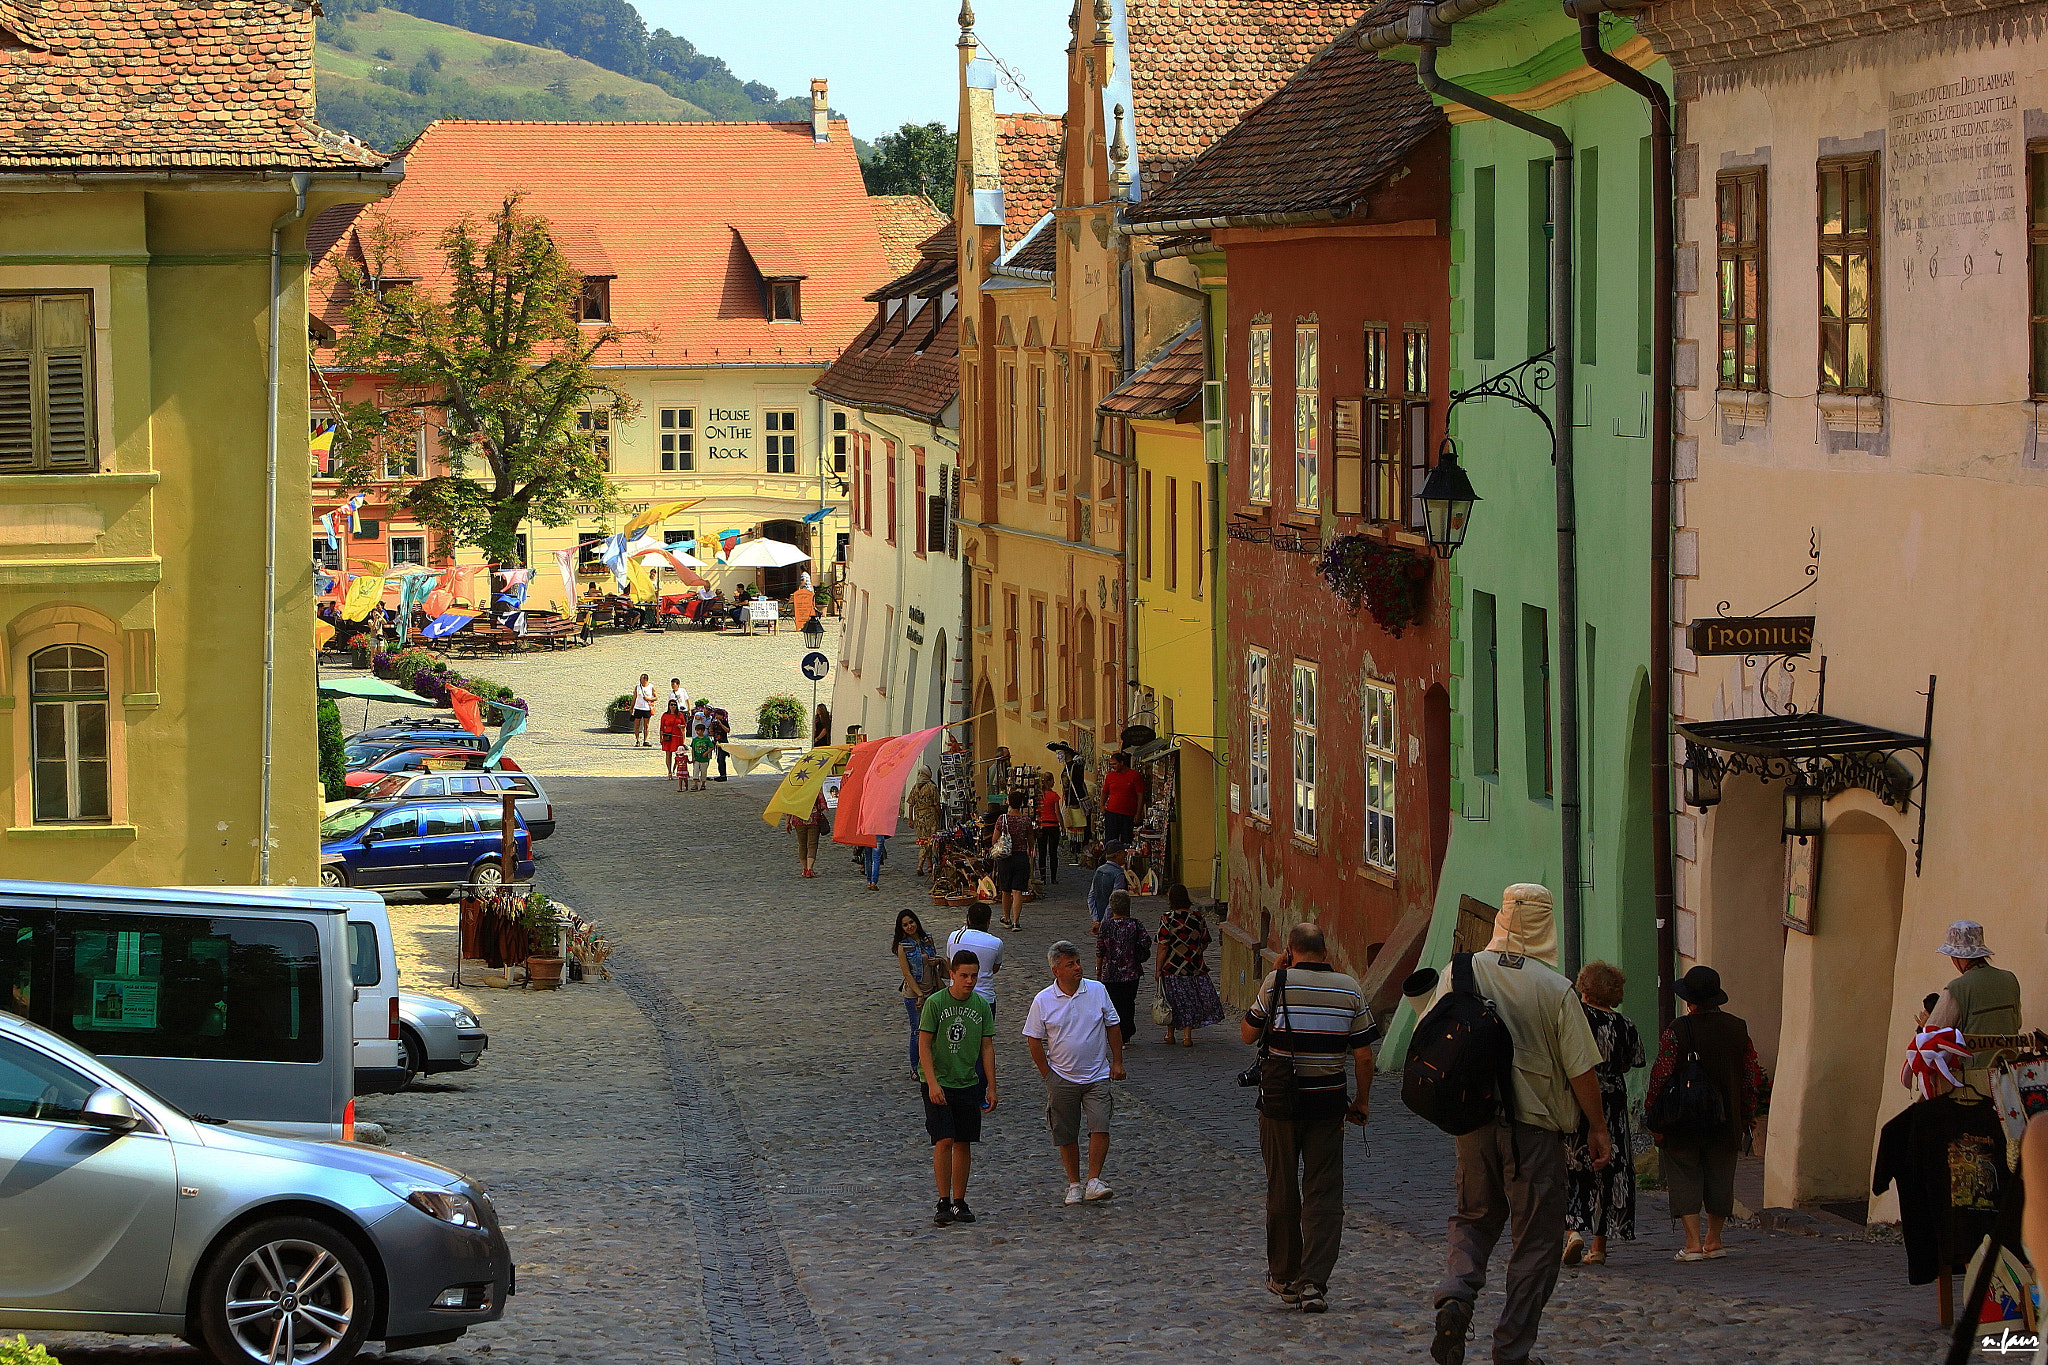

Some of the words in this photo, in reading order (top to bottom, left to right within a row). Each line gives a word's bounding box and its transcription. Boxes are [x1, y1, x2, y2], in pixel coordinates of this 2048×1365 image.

[1996, 95, 2018, 112] TELA
[709, 408, 750, 421] HOUSE
[705, 425, 726, 439] ON
[727, 425, 752, 439] THE
[708, 446, 748, 459] ROCK
[1968, 1035, 2028, 1050] OUVENIR
